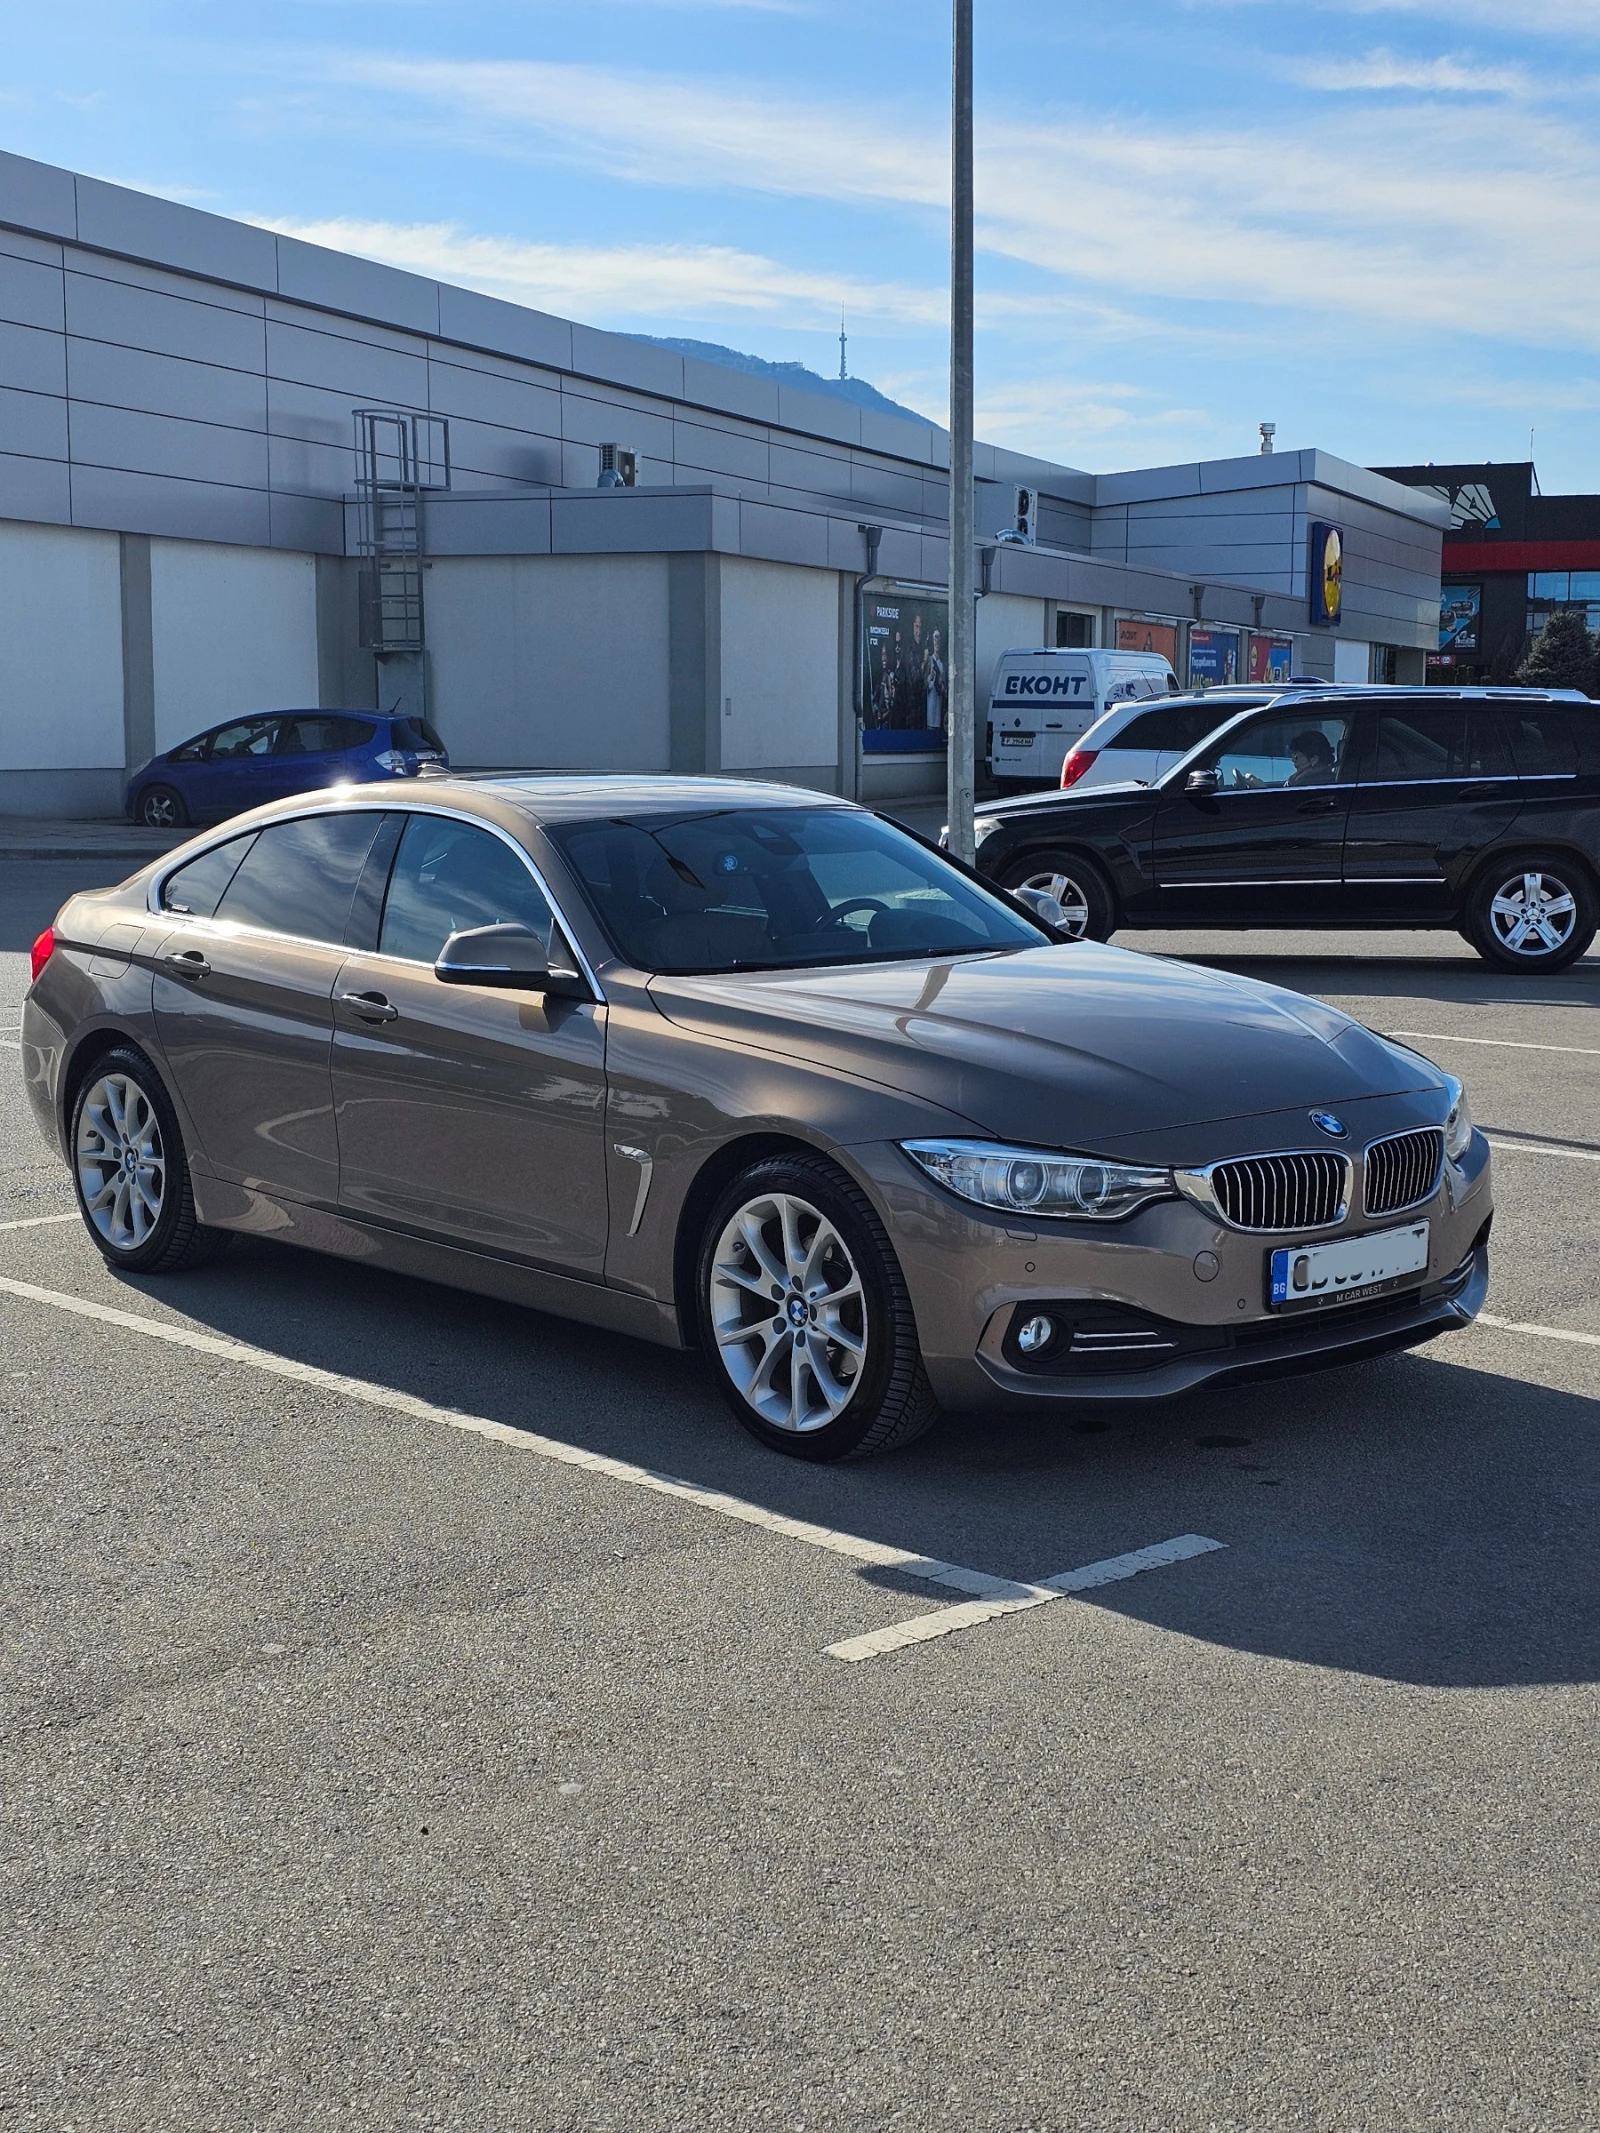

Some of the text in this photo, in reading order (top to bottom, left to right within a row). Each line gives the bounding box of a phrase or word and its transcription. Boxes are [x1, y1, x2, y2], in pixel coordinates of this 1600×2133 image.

[876, 606, 900, 619] PARKSIDE
[1005, 675, 1087, 695] ЕКОНТ
[1273, 1282, 1286, 1294] BG
[1336, 1284, 1383, 1302] M CAR WEST
